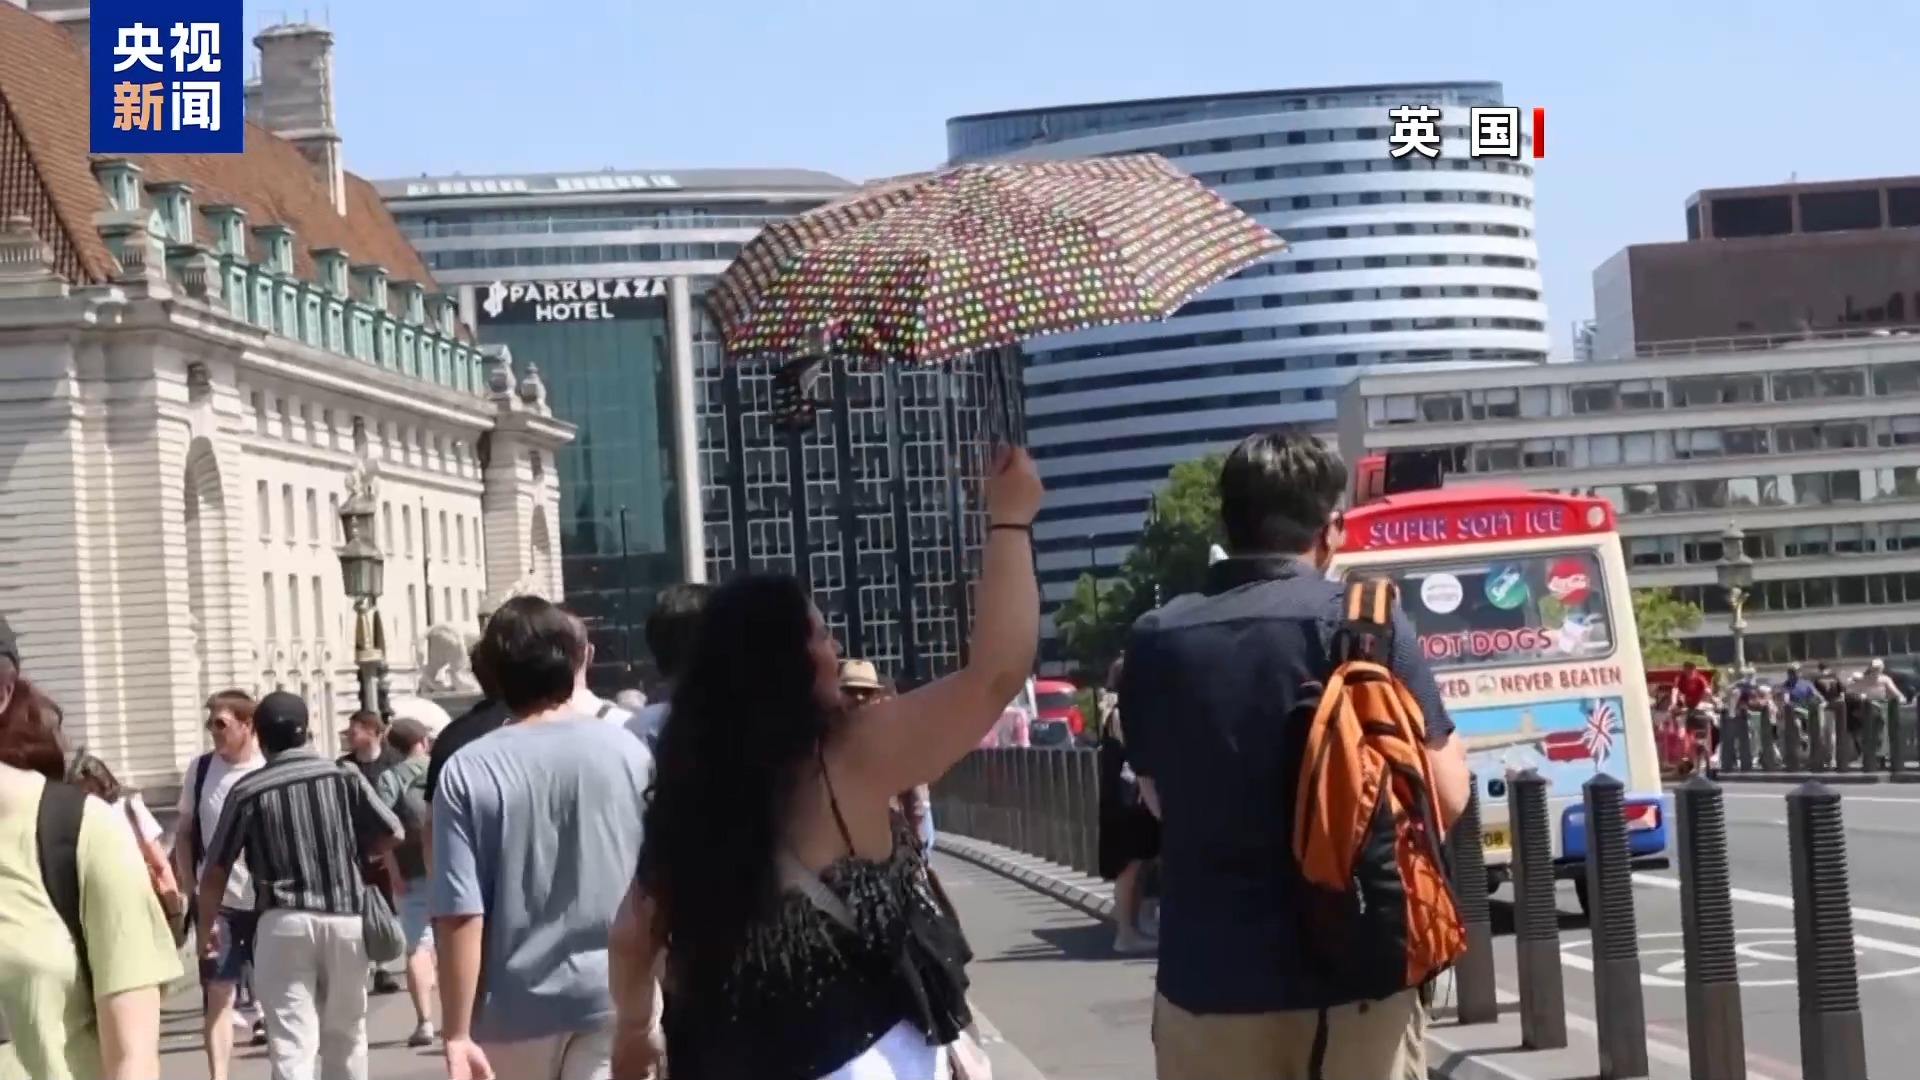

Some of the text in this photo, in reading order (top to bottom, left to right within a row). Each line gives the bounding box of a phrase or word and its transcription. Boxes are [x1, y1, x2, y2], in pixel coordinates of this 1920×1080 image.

[536, 301, 615, 321] HOTEL
[1369, 518, 1448, 546] SUPER
[1525, 508, 1562, 534] ICE
[1470, 627, 1552, 656] DOGS
[1500, 671, 1553, 692] NEVER
[1559, 666, 1622, 689] BEATEN
